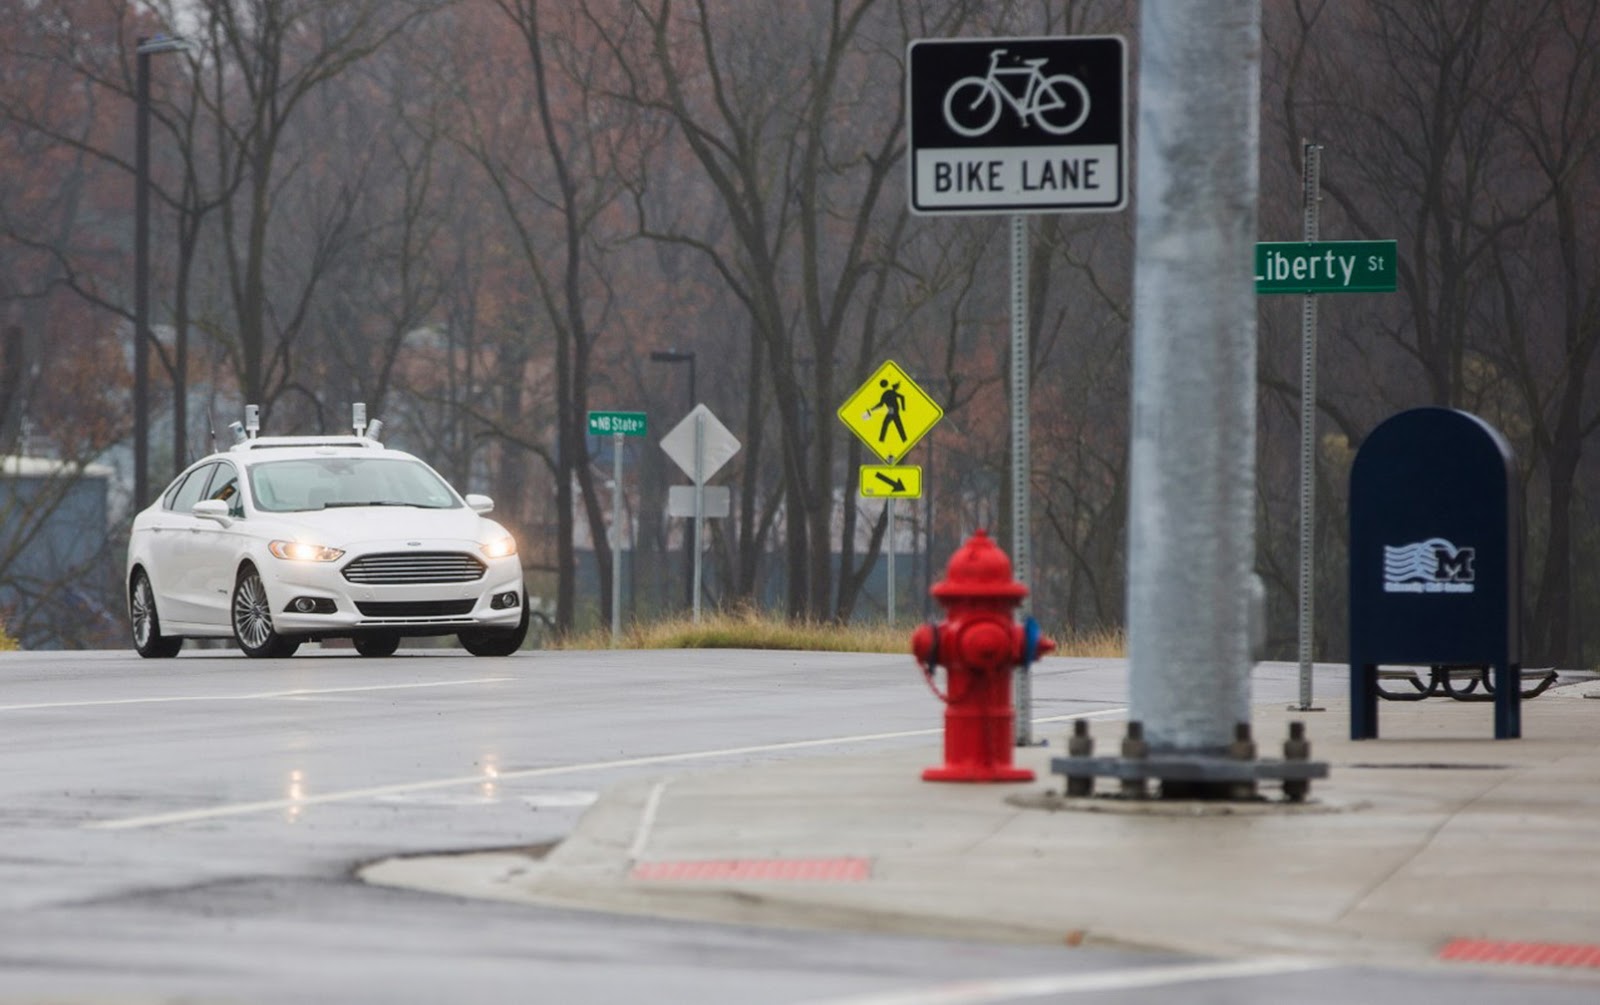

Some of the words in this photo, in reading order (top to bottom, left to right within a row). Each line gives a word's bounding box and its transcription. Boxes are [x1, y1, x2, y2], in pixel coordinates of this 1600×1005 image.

[935, 160, 1004, 193] BIKE
[1021, 157, 1100, 191] LANE
[1368, 254, 1385, 272] St
[597, 416, 611, 431] NB
[612, 416, 638, 432] State
[1434, 547, 1475, 582] M
